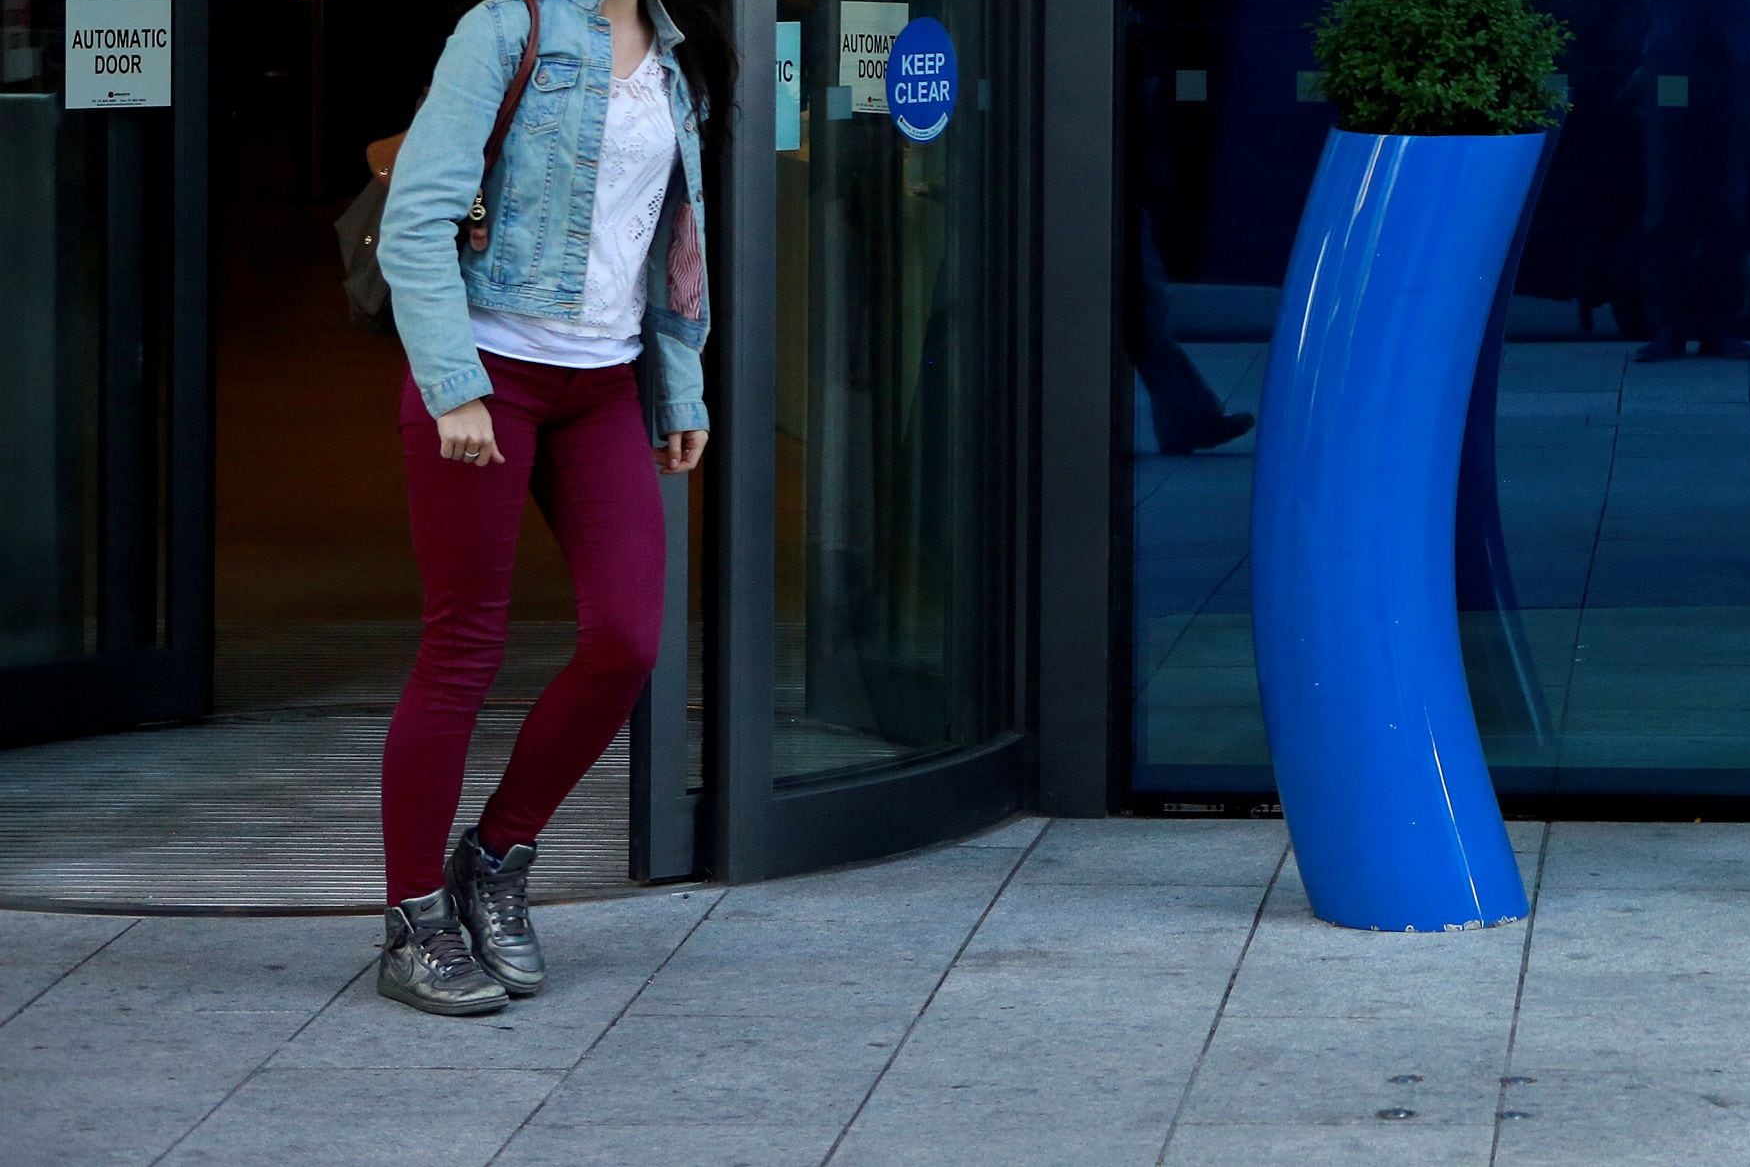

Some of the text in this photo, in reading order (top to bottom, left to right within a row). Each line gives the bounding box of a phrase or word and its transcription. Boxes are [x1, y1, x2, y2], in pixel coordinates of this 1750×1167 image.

[72, 29, 167, 49] AUTOMATIC
[843, 34, 896, 54] AUTOMAT
[95, 55, 142, 74] DOOR
[902, 53, 946, 76] KEEP
[895, 81, 951, 104] CLEAR
